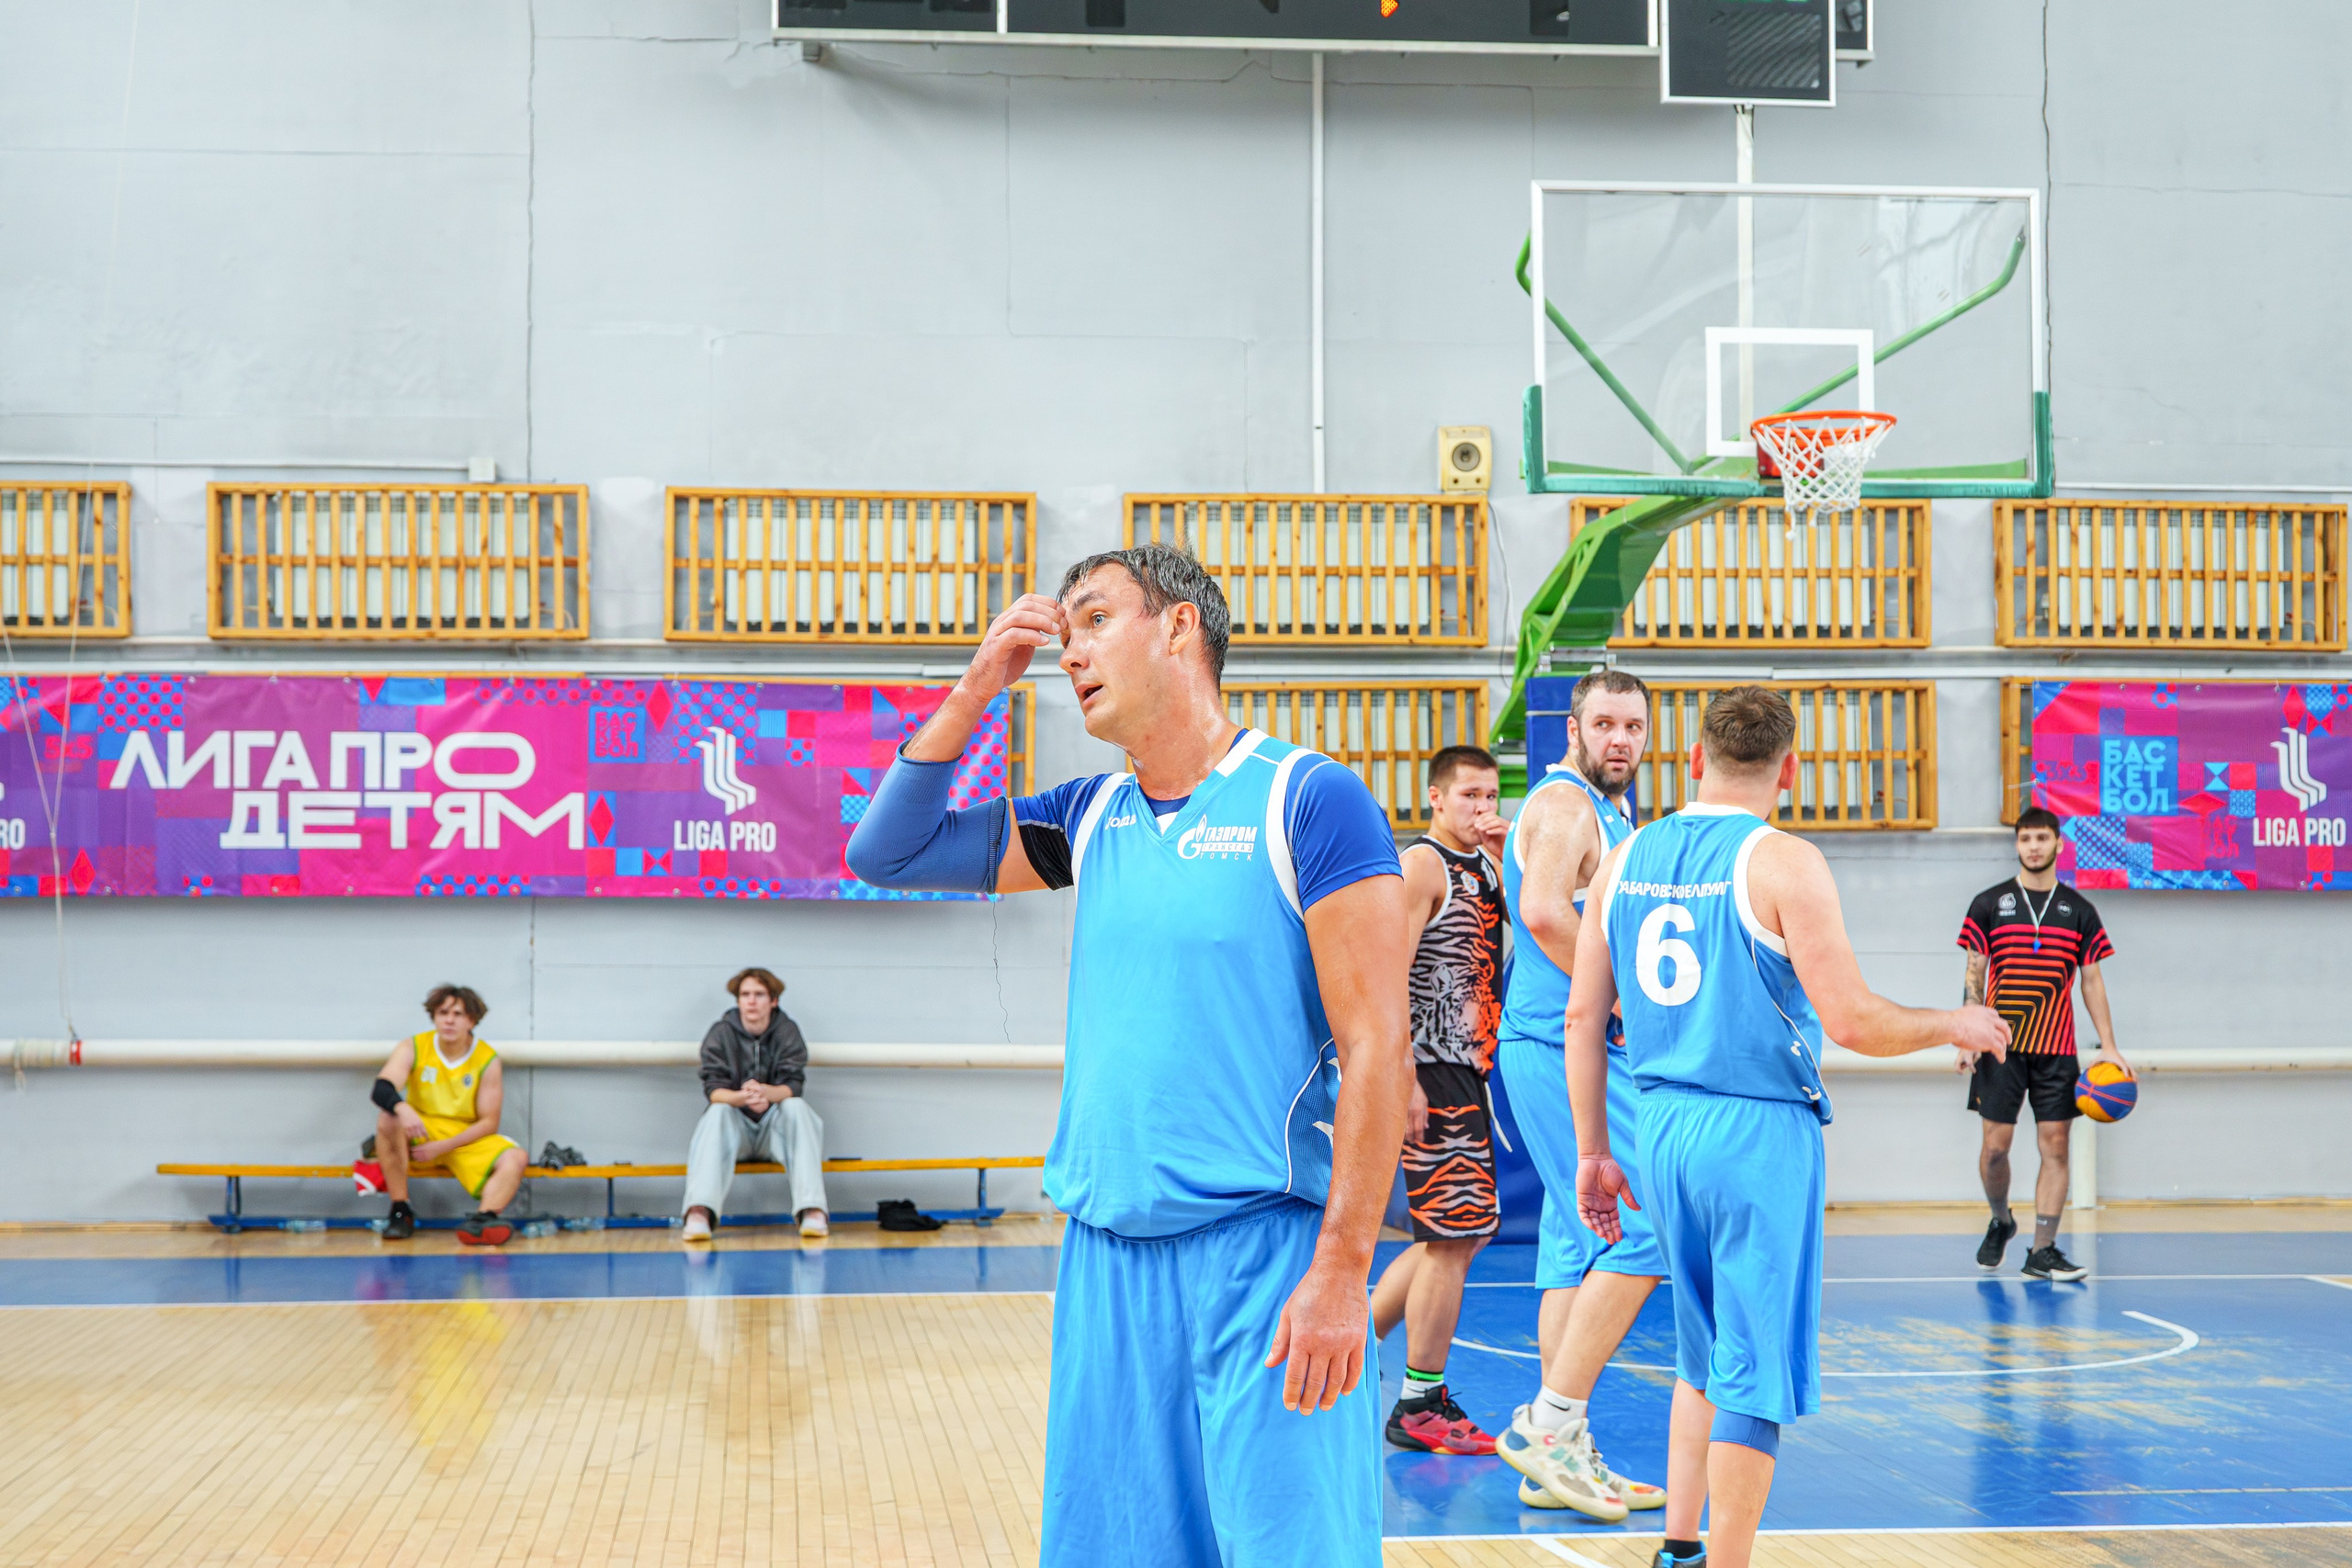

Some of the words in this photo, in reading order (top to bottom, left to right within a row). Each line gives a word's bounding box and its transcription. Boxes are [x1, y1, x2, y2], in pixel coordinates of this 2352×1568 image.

[109, 730, 319, 790] ЛИГА
[330, 731, 537, 790] ПРО
[2104, 739, 2166, 764] БАС
[2104, 763, 2165, 788] КЕТ
[2104, 787, 2169, 814] БОЛ
[220, 790, 585, 850] ДЕТЯМ
[1204, 826, 1258, 842] ГАЗПРОМ
[2253, 817, 2301, 847] LIGA
[2304, 817, 2346, 847] PRO
[673, 819, 727, 852] LIGA
[729, 820, 777, 853] PRO
[1200, 852, 1252, 862] ТОМСК
[1635, 903, 1702, 1007] 6
